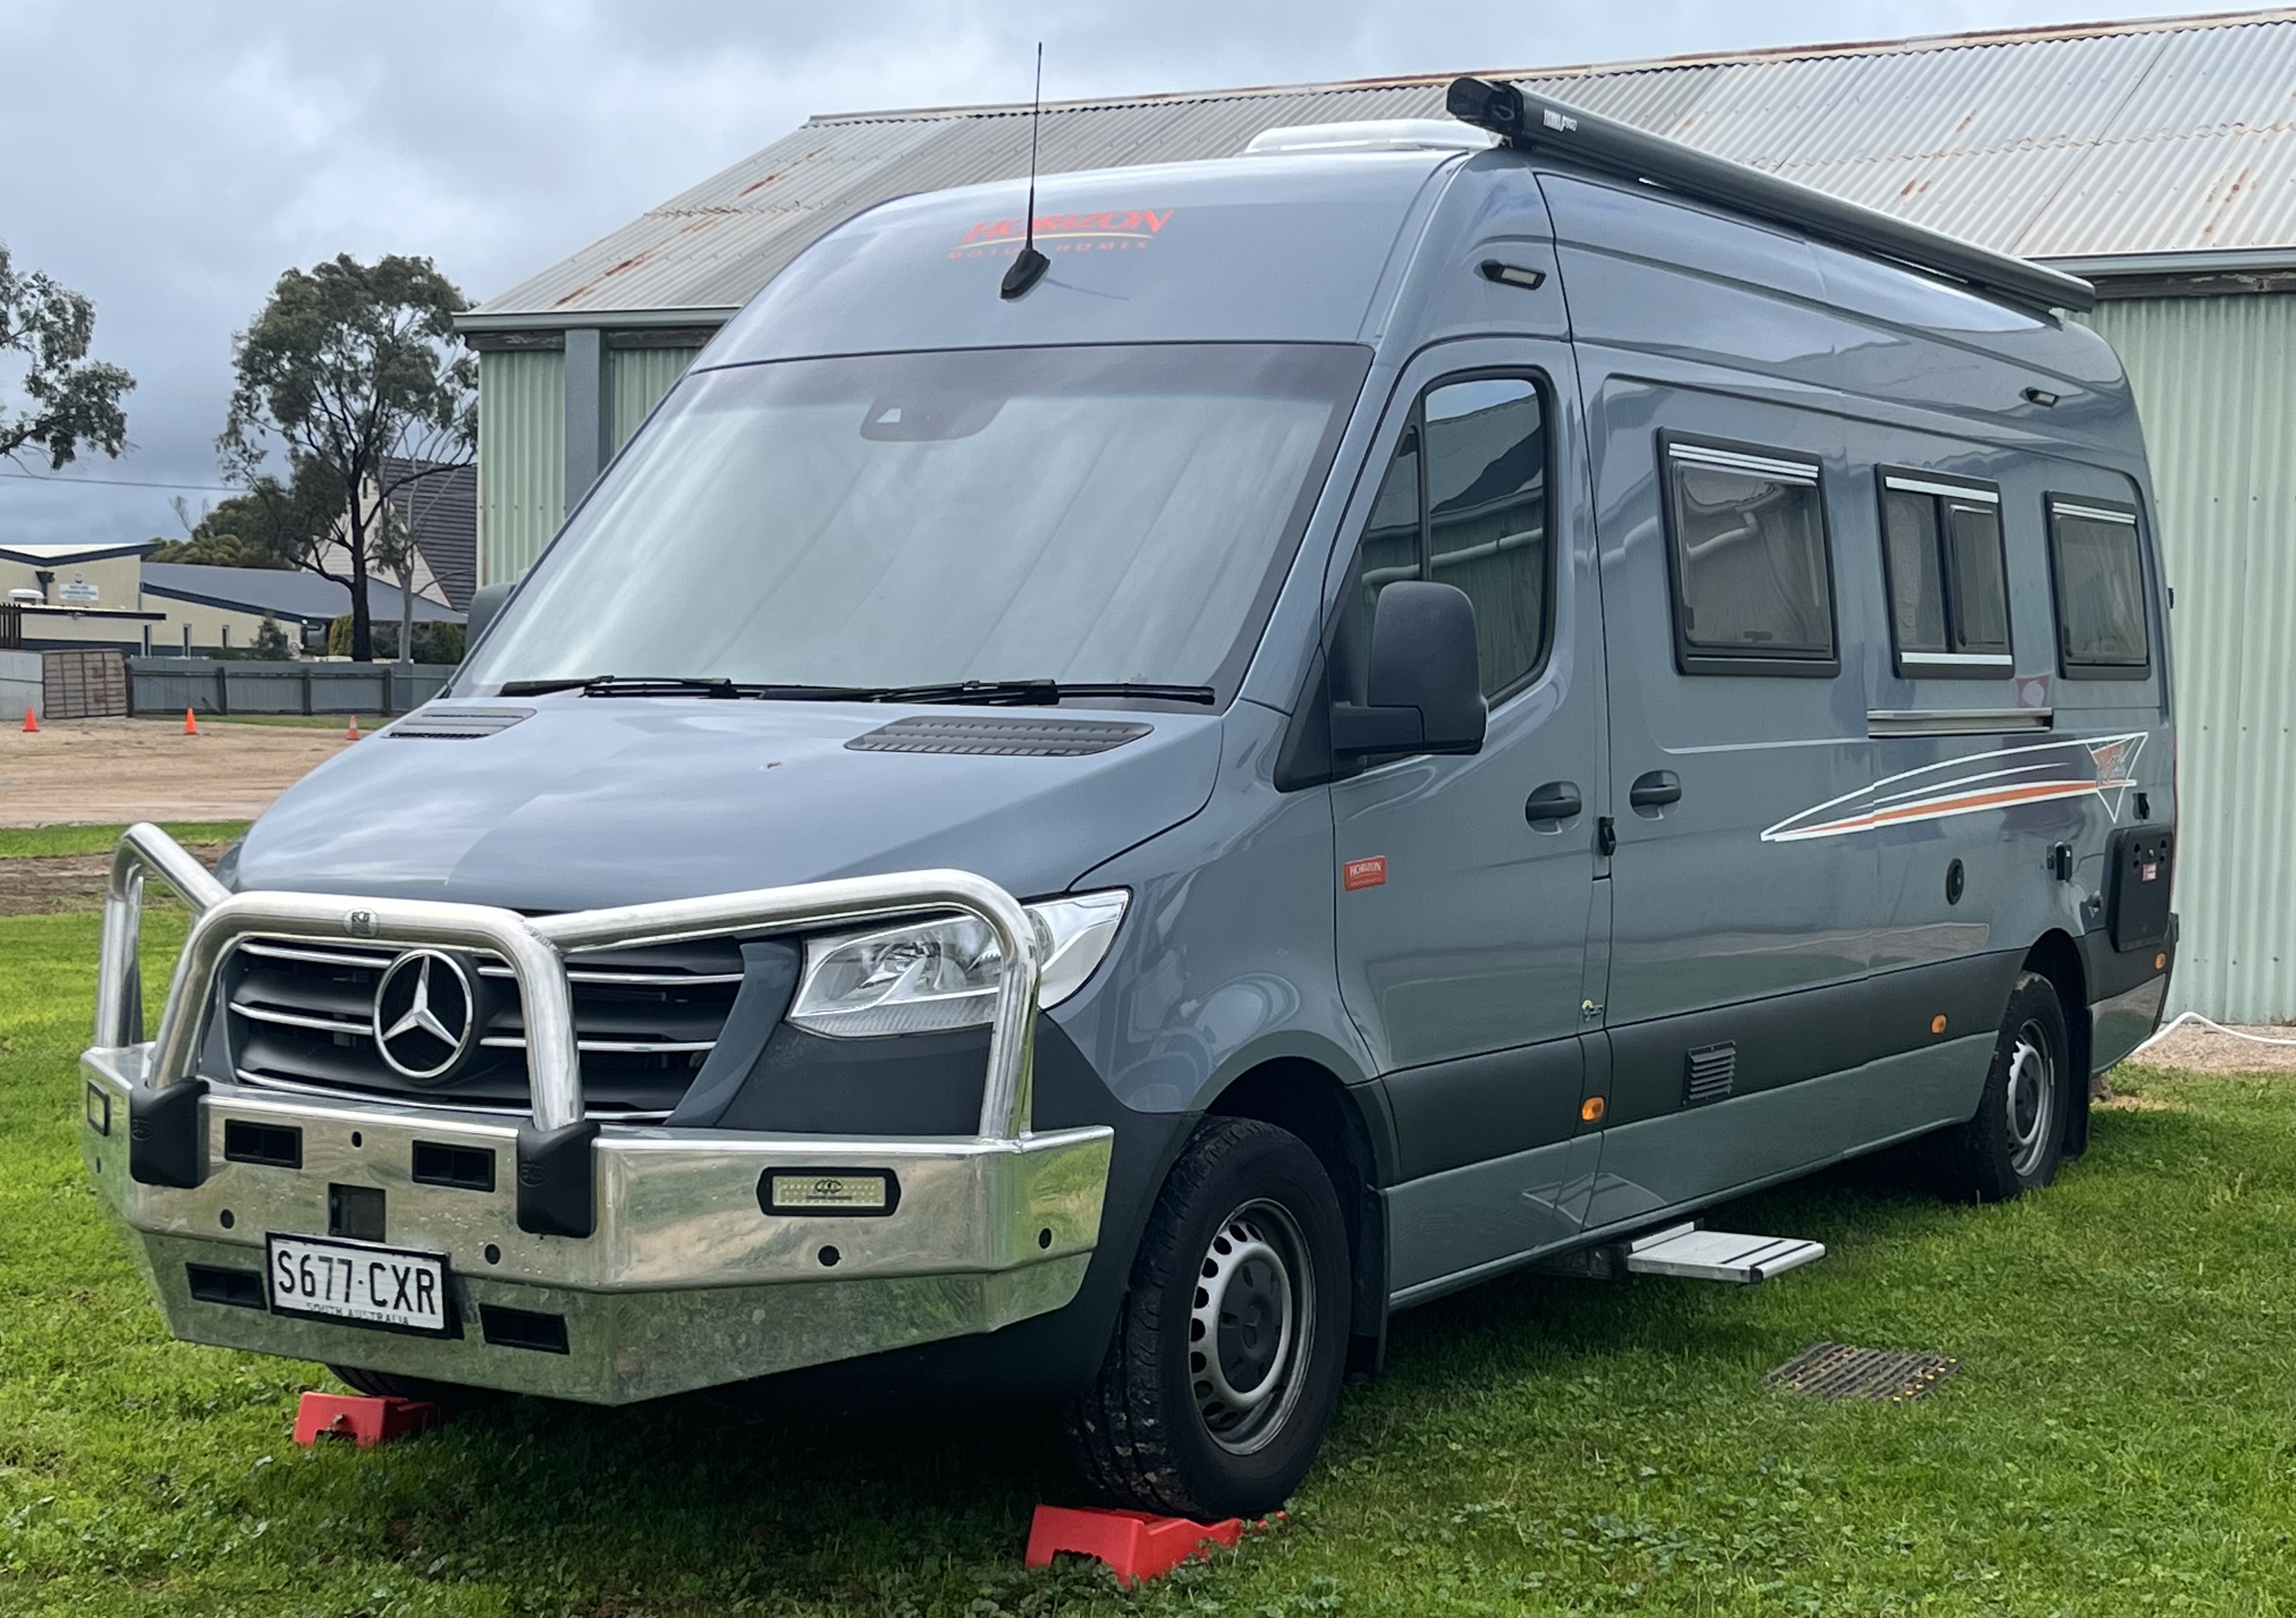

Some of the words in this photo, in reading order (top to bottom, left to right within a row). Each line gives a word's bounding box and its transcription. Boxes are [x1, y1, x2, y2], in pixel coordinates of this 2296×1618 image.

[962, 209, 1175, 244] HORIZON
[1349, 861, 1382, 878] HORIZON
[306, 1302, 343, 1316] SOUTH
[348, 1308, 409, 1325] AUSTRALIA
